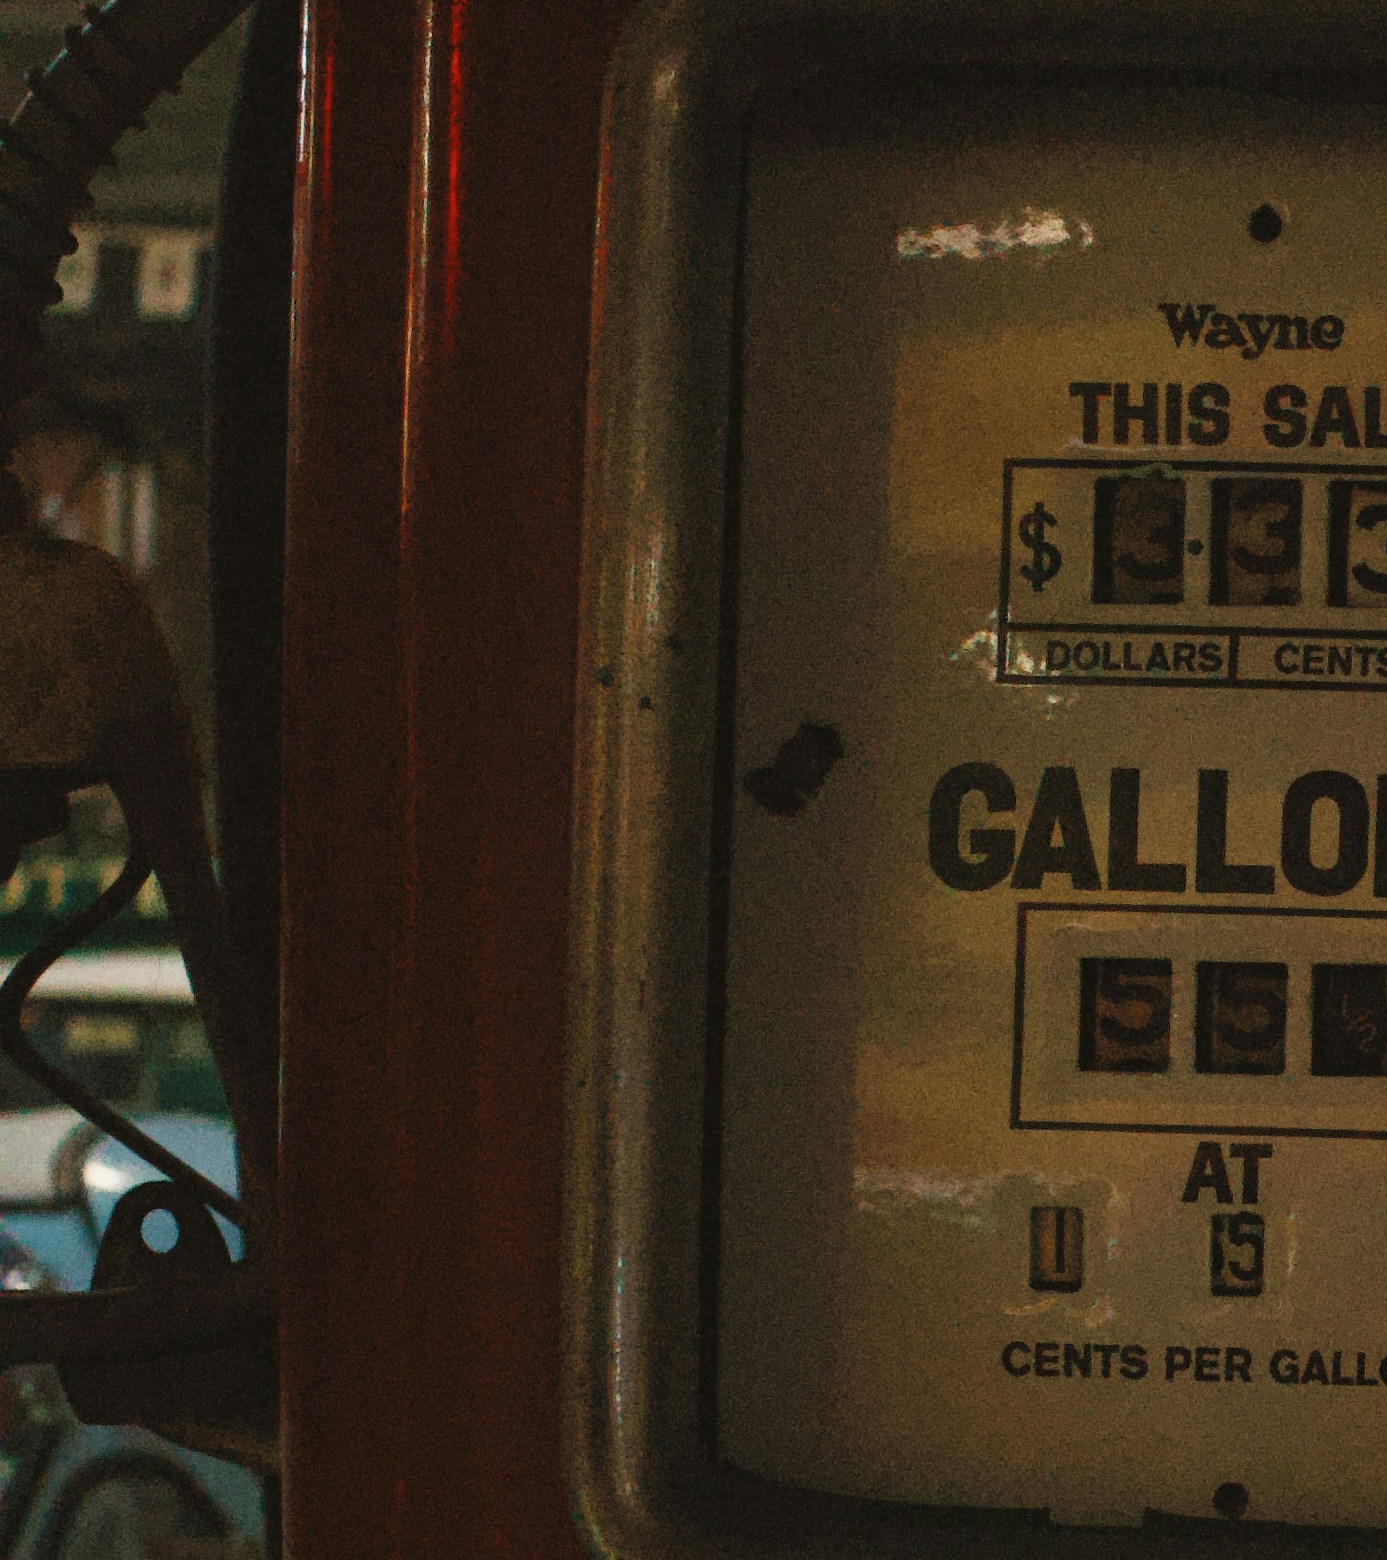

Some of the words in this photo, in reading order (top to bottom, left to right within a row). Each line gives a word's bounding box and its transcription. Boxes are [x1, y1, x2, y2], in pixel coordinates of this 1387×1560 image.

[1158, 302, 1345, 359] Wayne
[1069, 382, 1231, 446] THIS
[1045, 640, 1224, 676] DOLLARS
[1182, 1141, 1273, 1205] AT
[1001, 1341, 1149, 1381] CENTS
[1164, 1346, 1253, 1384] PER
